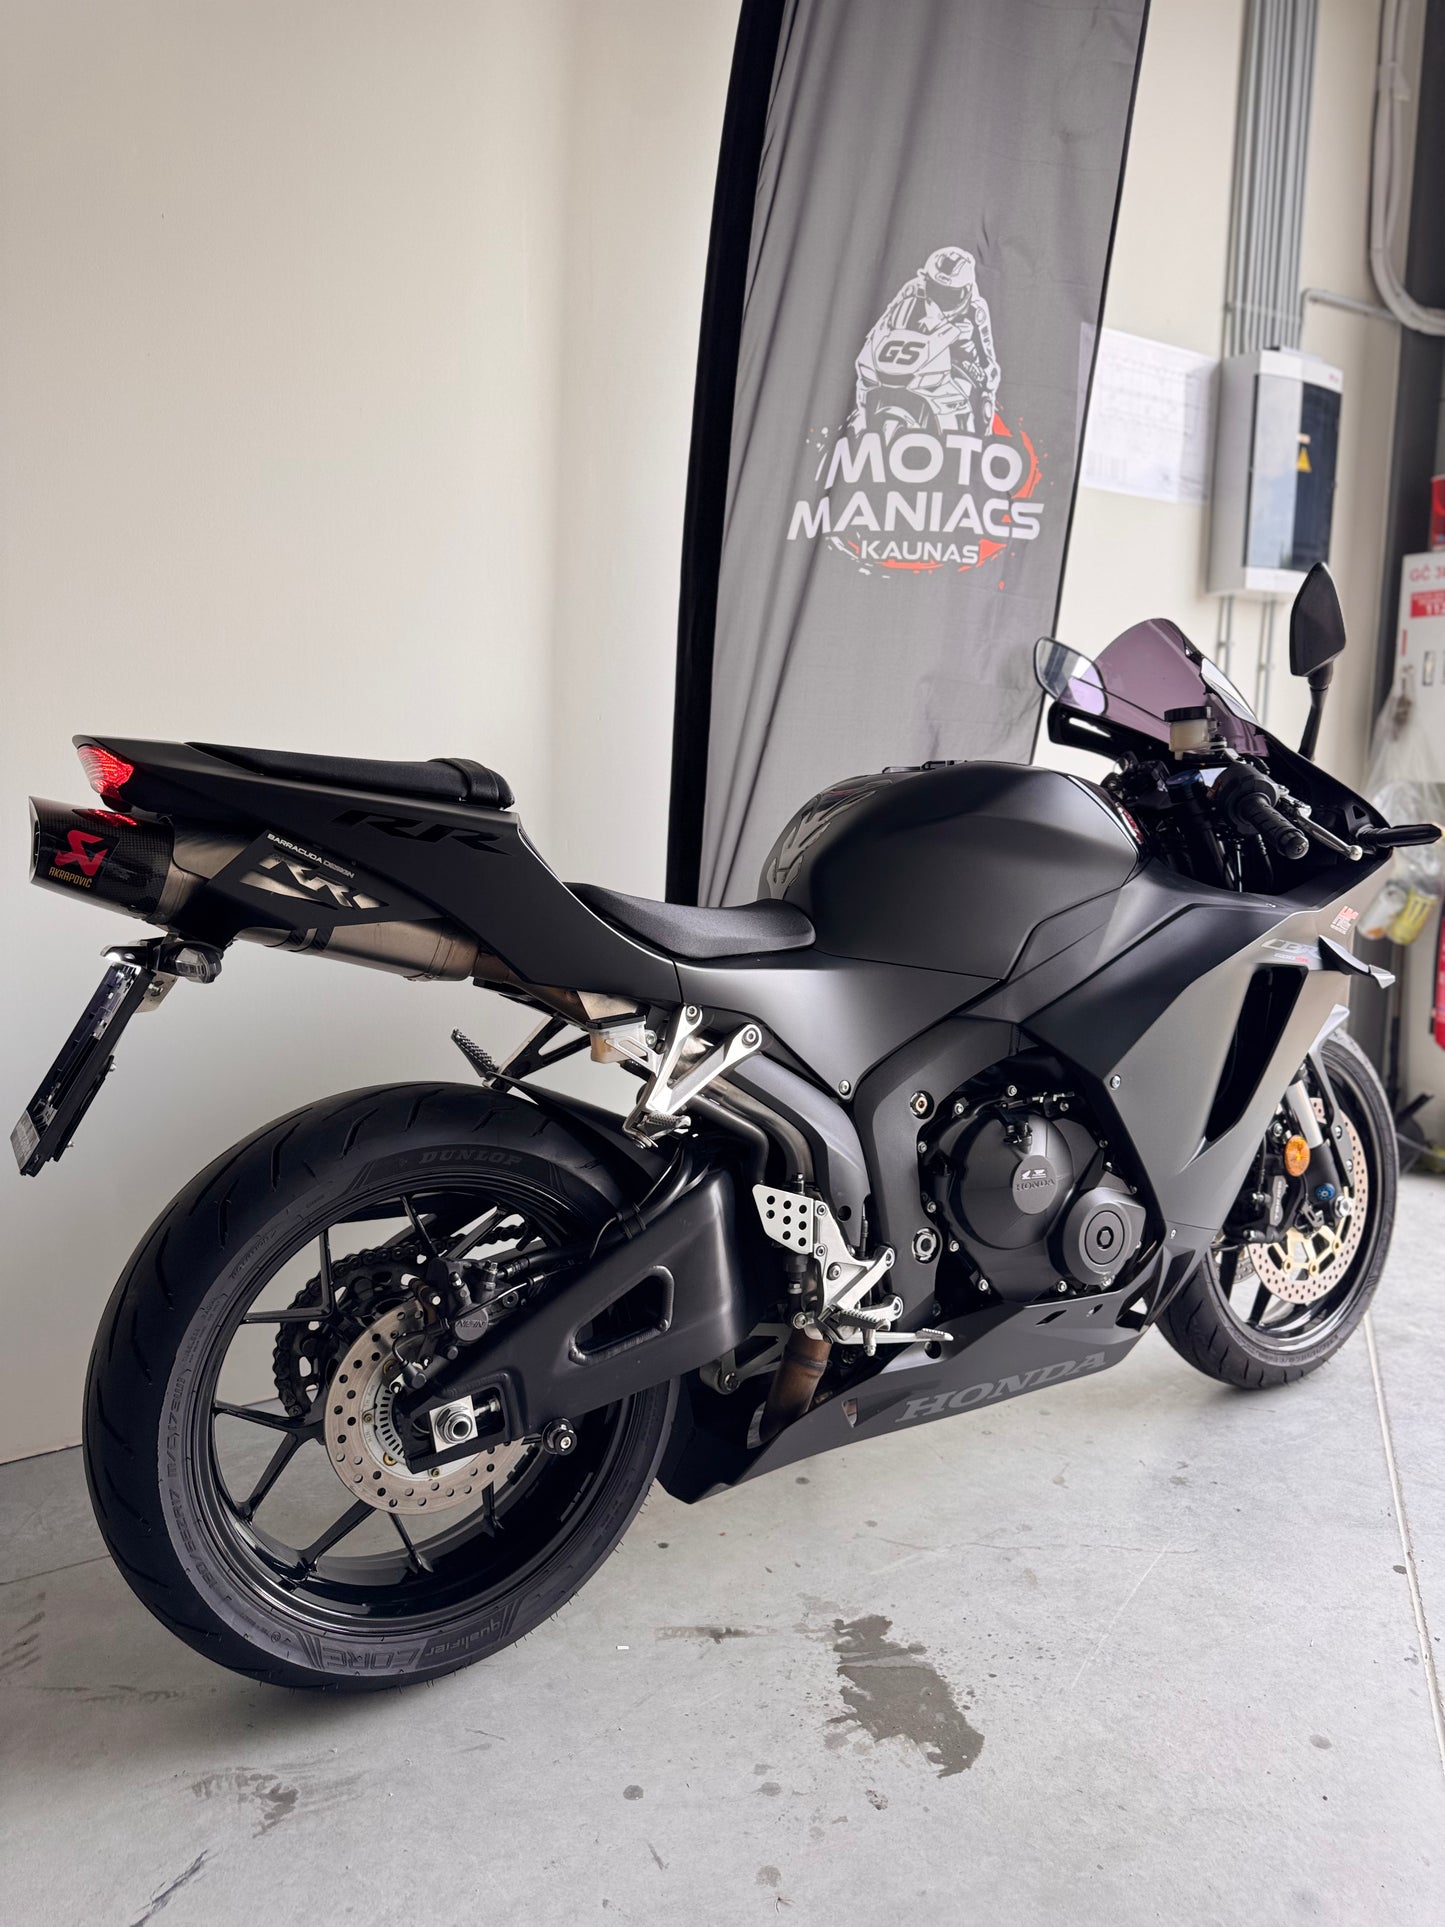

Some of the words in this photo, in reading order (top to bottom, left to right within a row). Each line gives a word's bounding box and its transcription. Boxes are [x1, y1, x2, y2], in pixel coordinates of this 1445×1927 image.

[878, 340, 926, 366] GS
[824, 432, 1023, 492] MOTO
[787, 490, 1045, 541] MANIACS
[860, 539, 981, 565] KAUNAS
[266, 832, 324, 864] BARRACUDA
[322, 859, 355, 880] DESIGN
[331, 809, 513, 857] RR
[419, 1148, 523, 1166] DUNLOP
[1016, 1179, 1055, 1191] HONDA
[894, 1351, 1106, 1424] HONDA
